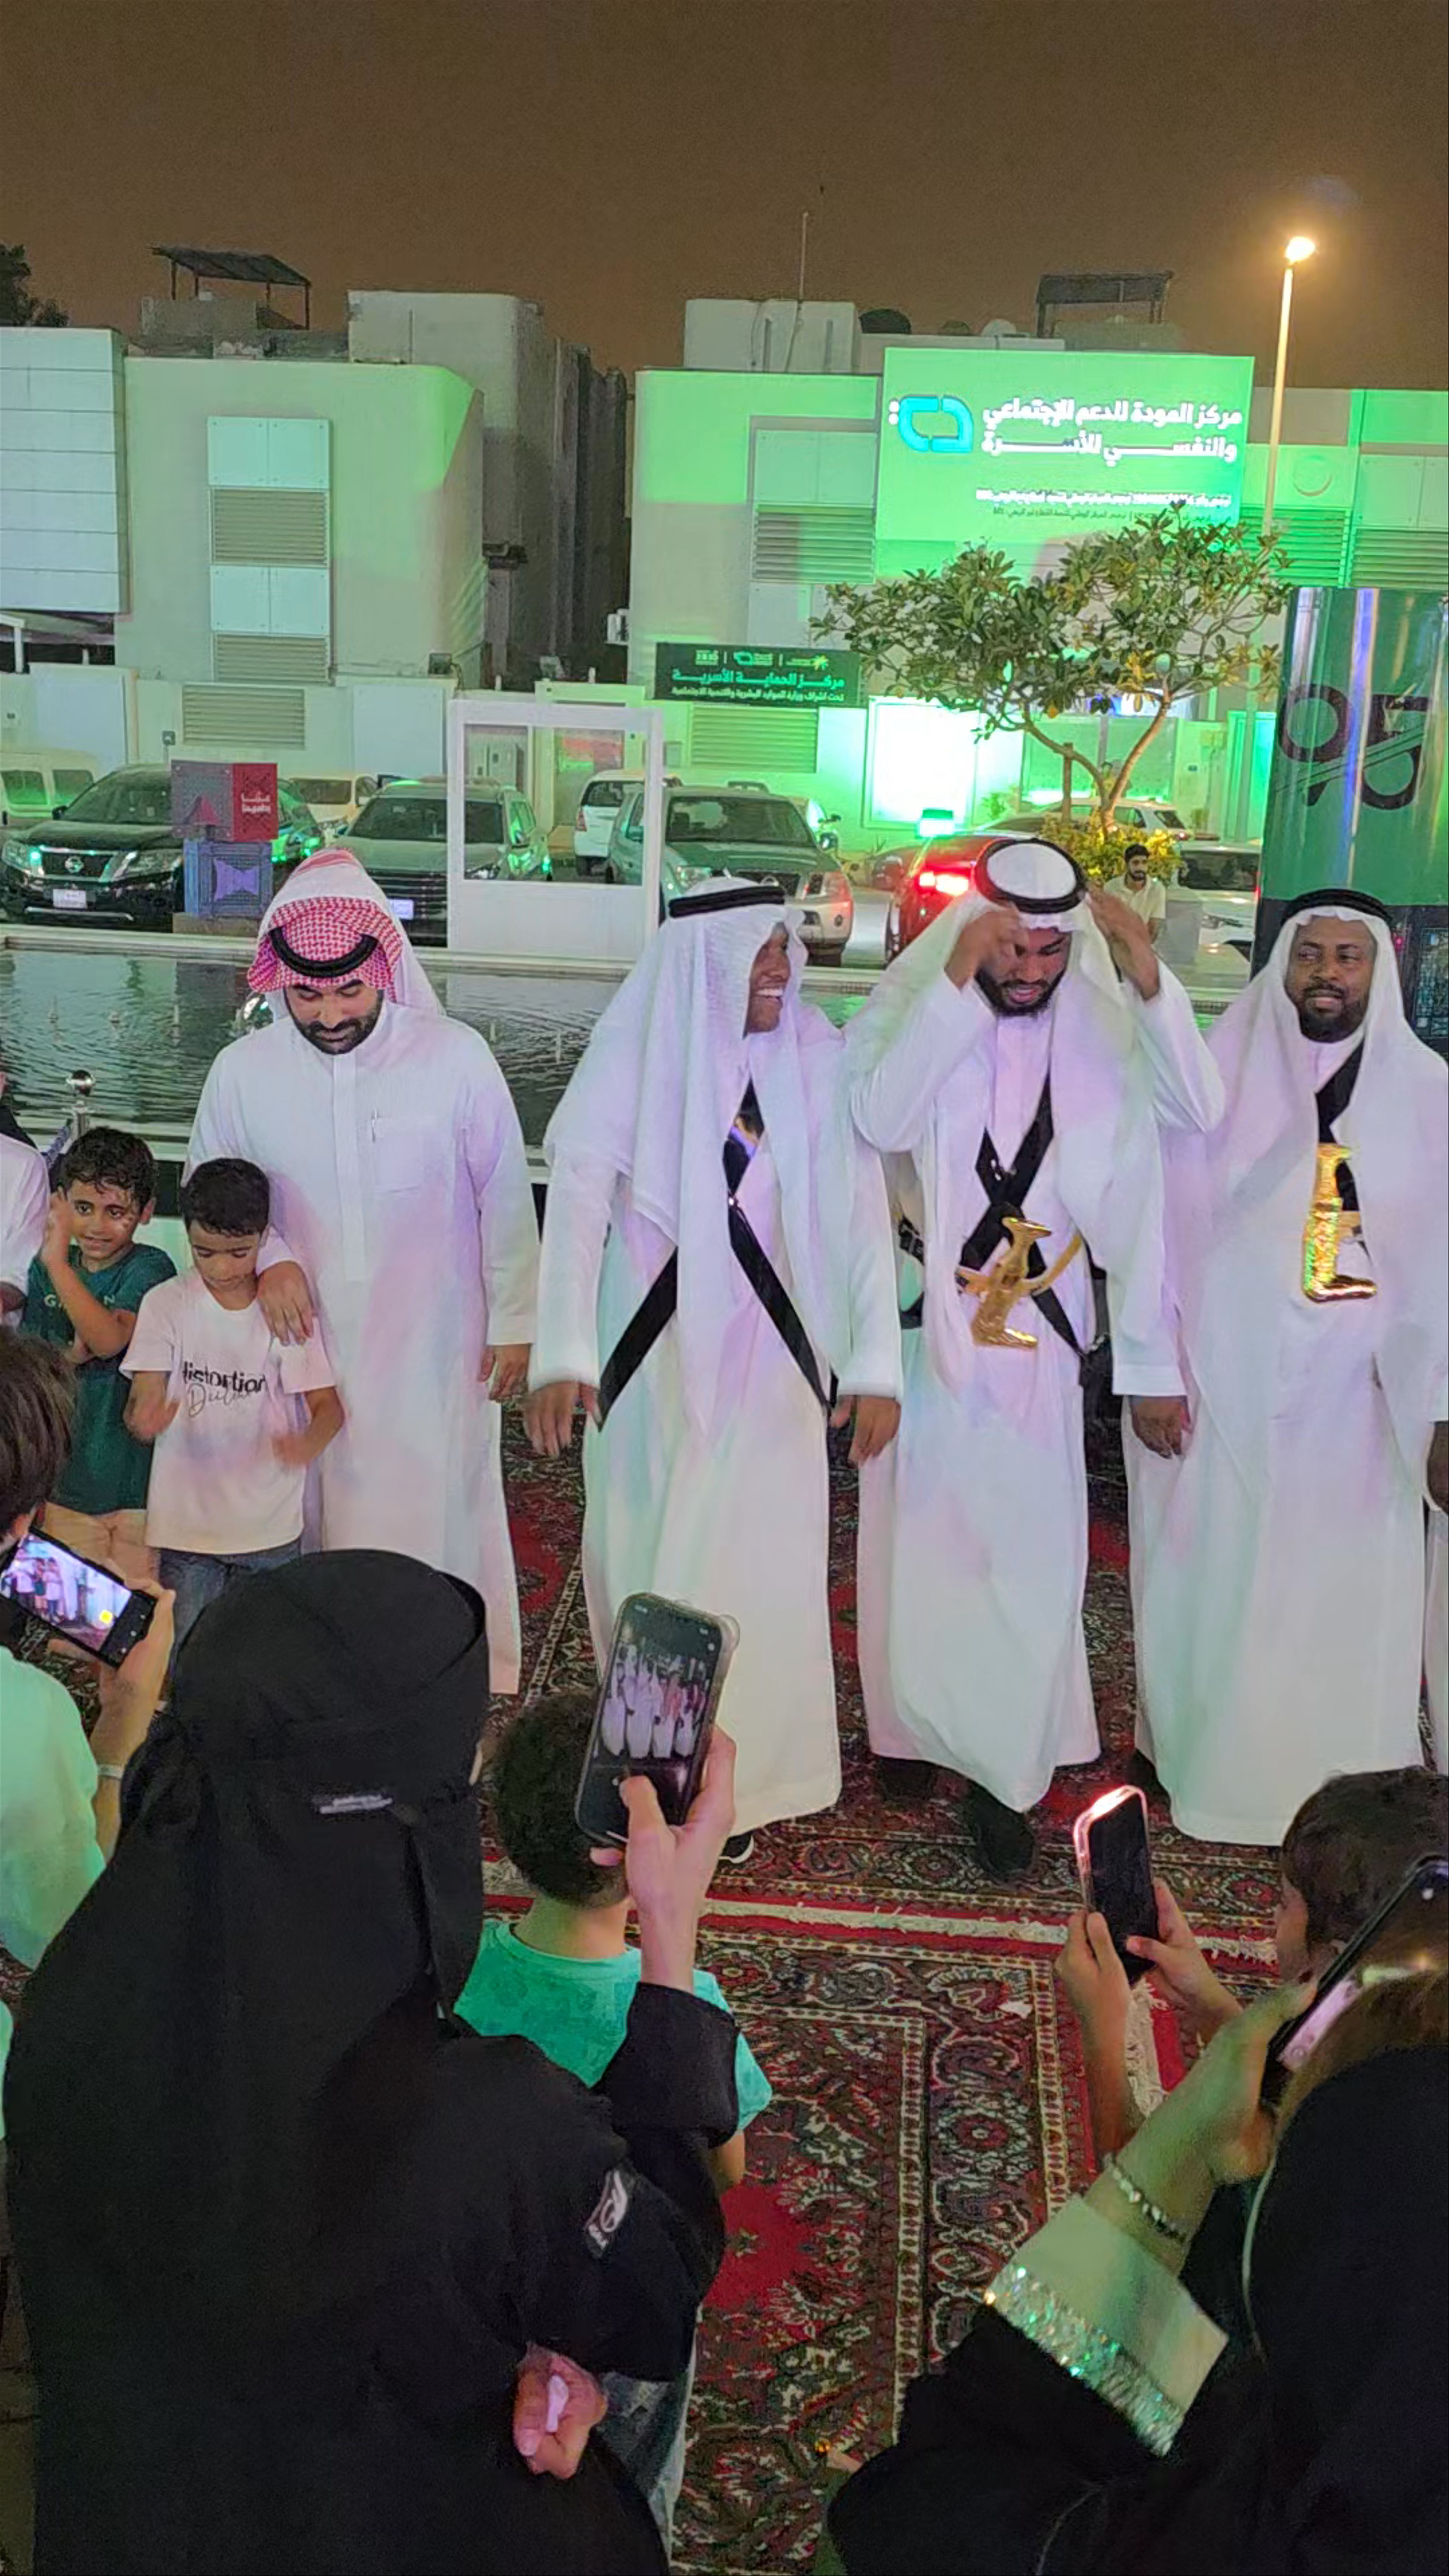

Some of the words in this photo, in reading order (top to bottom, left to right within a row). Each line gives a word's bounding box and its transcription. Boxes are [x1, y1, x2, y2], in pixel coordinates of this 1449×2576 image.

[1075, 400, 1129, 426] للدعم
[1130, 400, 1194, 427] المودة
[1194, 403, 1242, 429] مركز
